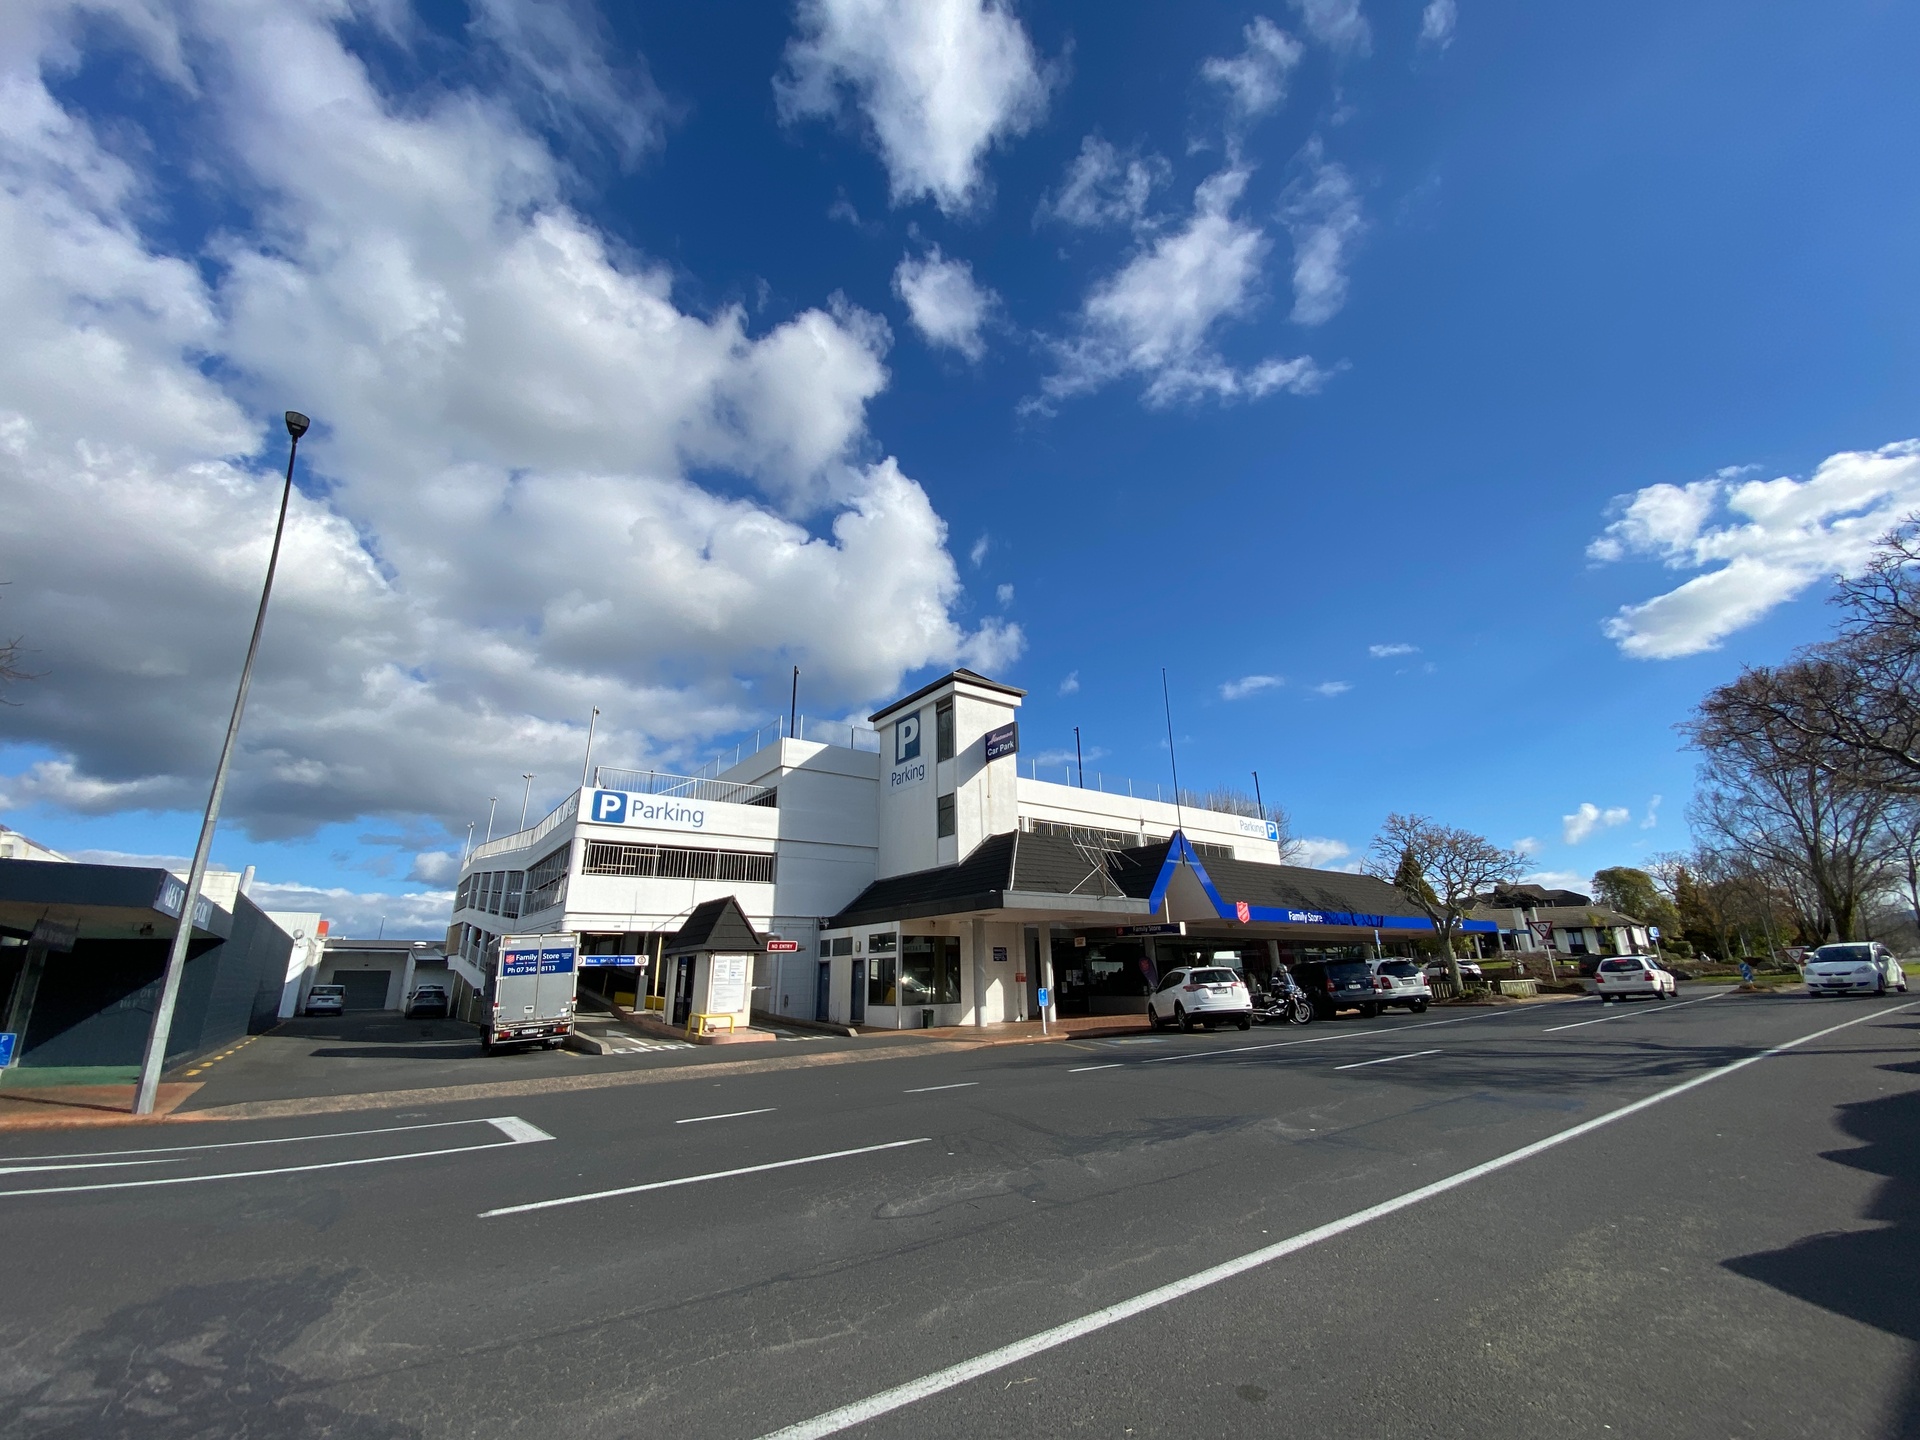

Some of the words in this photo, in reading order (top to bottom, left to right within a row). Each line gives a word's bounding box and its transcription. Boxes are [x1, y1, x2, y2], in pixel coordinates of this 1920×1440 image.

[898, 717, 919, 760] P
[987, 746, 998, 756] Car
[1000, 741, 1014, 752] Park
[891, 764, 925, 787] Parking
[599, 794, 621, 819] P
[631, 799, 705, 828] Parking
[1240, 819, 1265, 836] Parking
[1267, 824, 1275, 837] P
[1288, 911, 1308, 924] Family
[1308, 912, 1323, 923] Store
[516, 953, 538, 962] Family
[542, 952, 560, 960] Store
[612, 1043, 697, 1054] ENTRY
